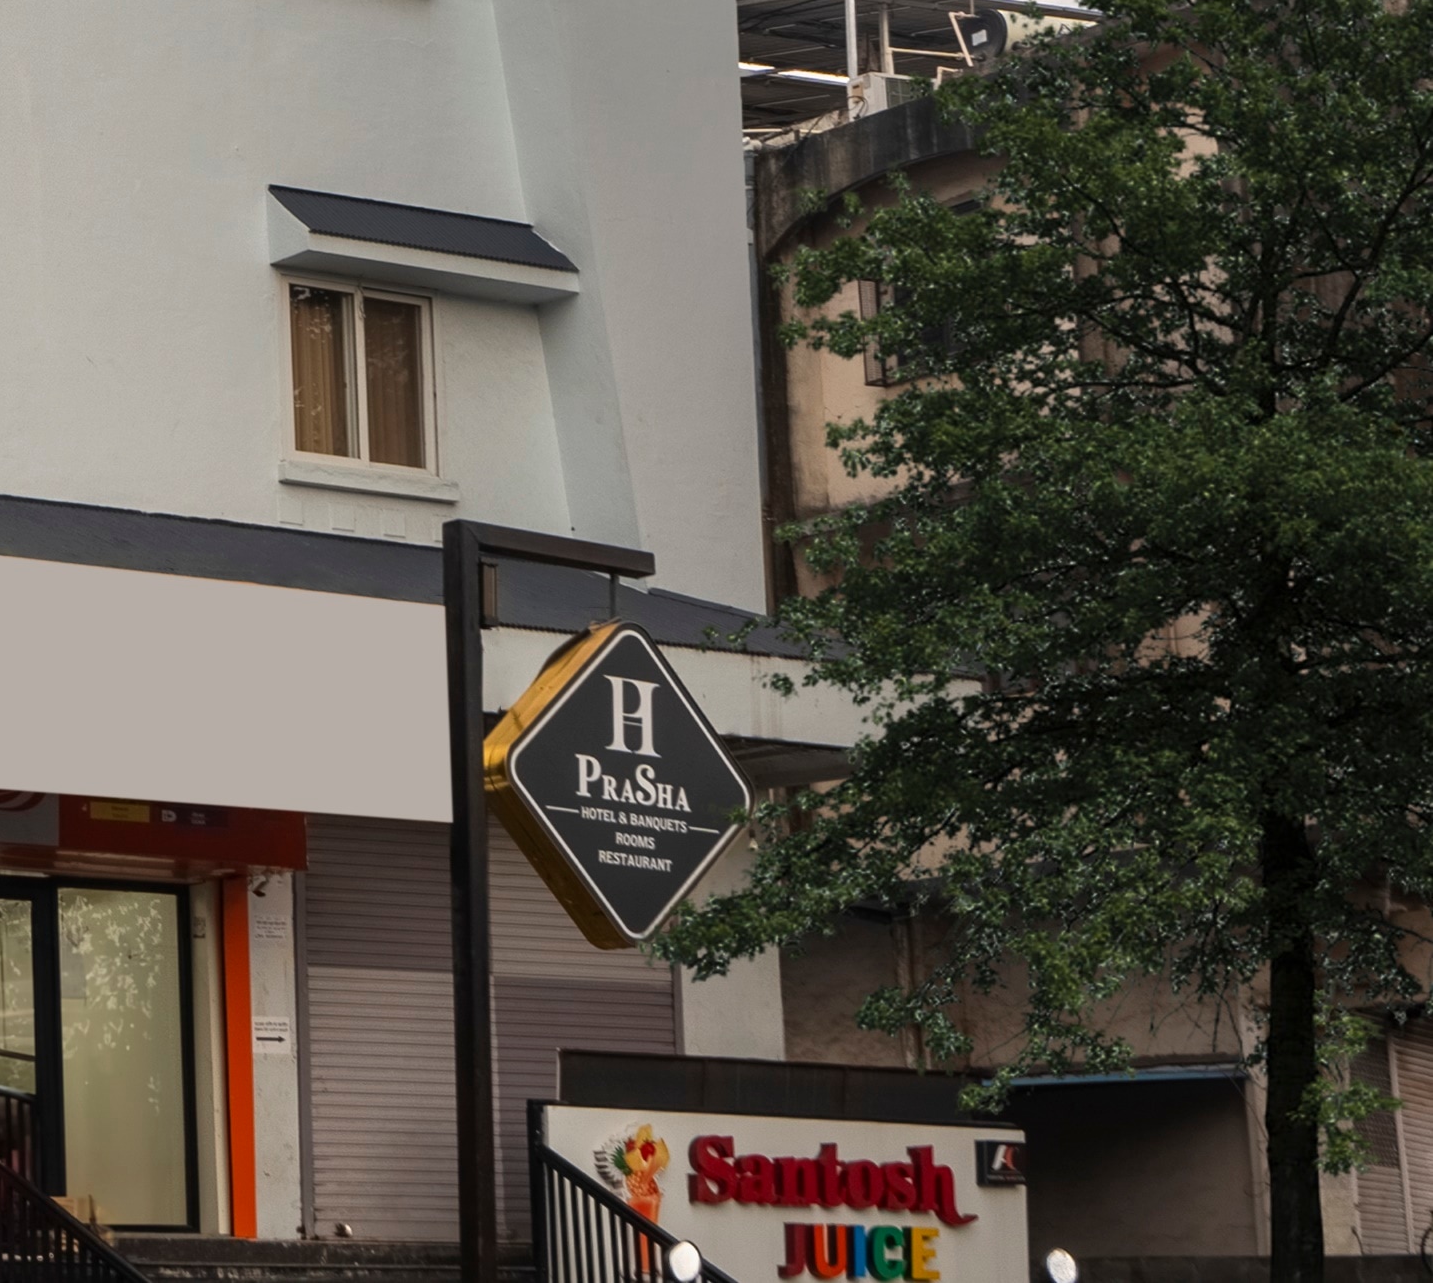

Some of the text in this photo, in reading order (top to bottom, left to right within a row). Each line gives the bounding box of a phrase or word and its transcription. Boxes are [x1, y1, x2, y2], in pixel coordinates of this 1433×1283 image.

[581, 806, 688, 834] HOTEL & BANQUETS
[615, 831, 656, 850] ROOMS
[598, 849, 673, 873] RESTAURANT
[687, 1135, 979, 1227] Santosh
[777, 1222, 940, 1281] JUICE
